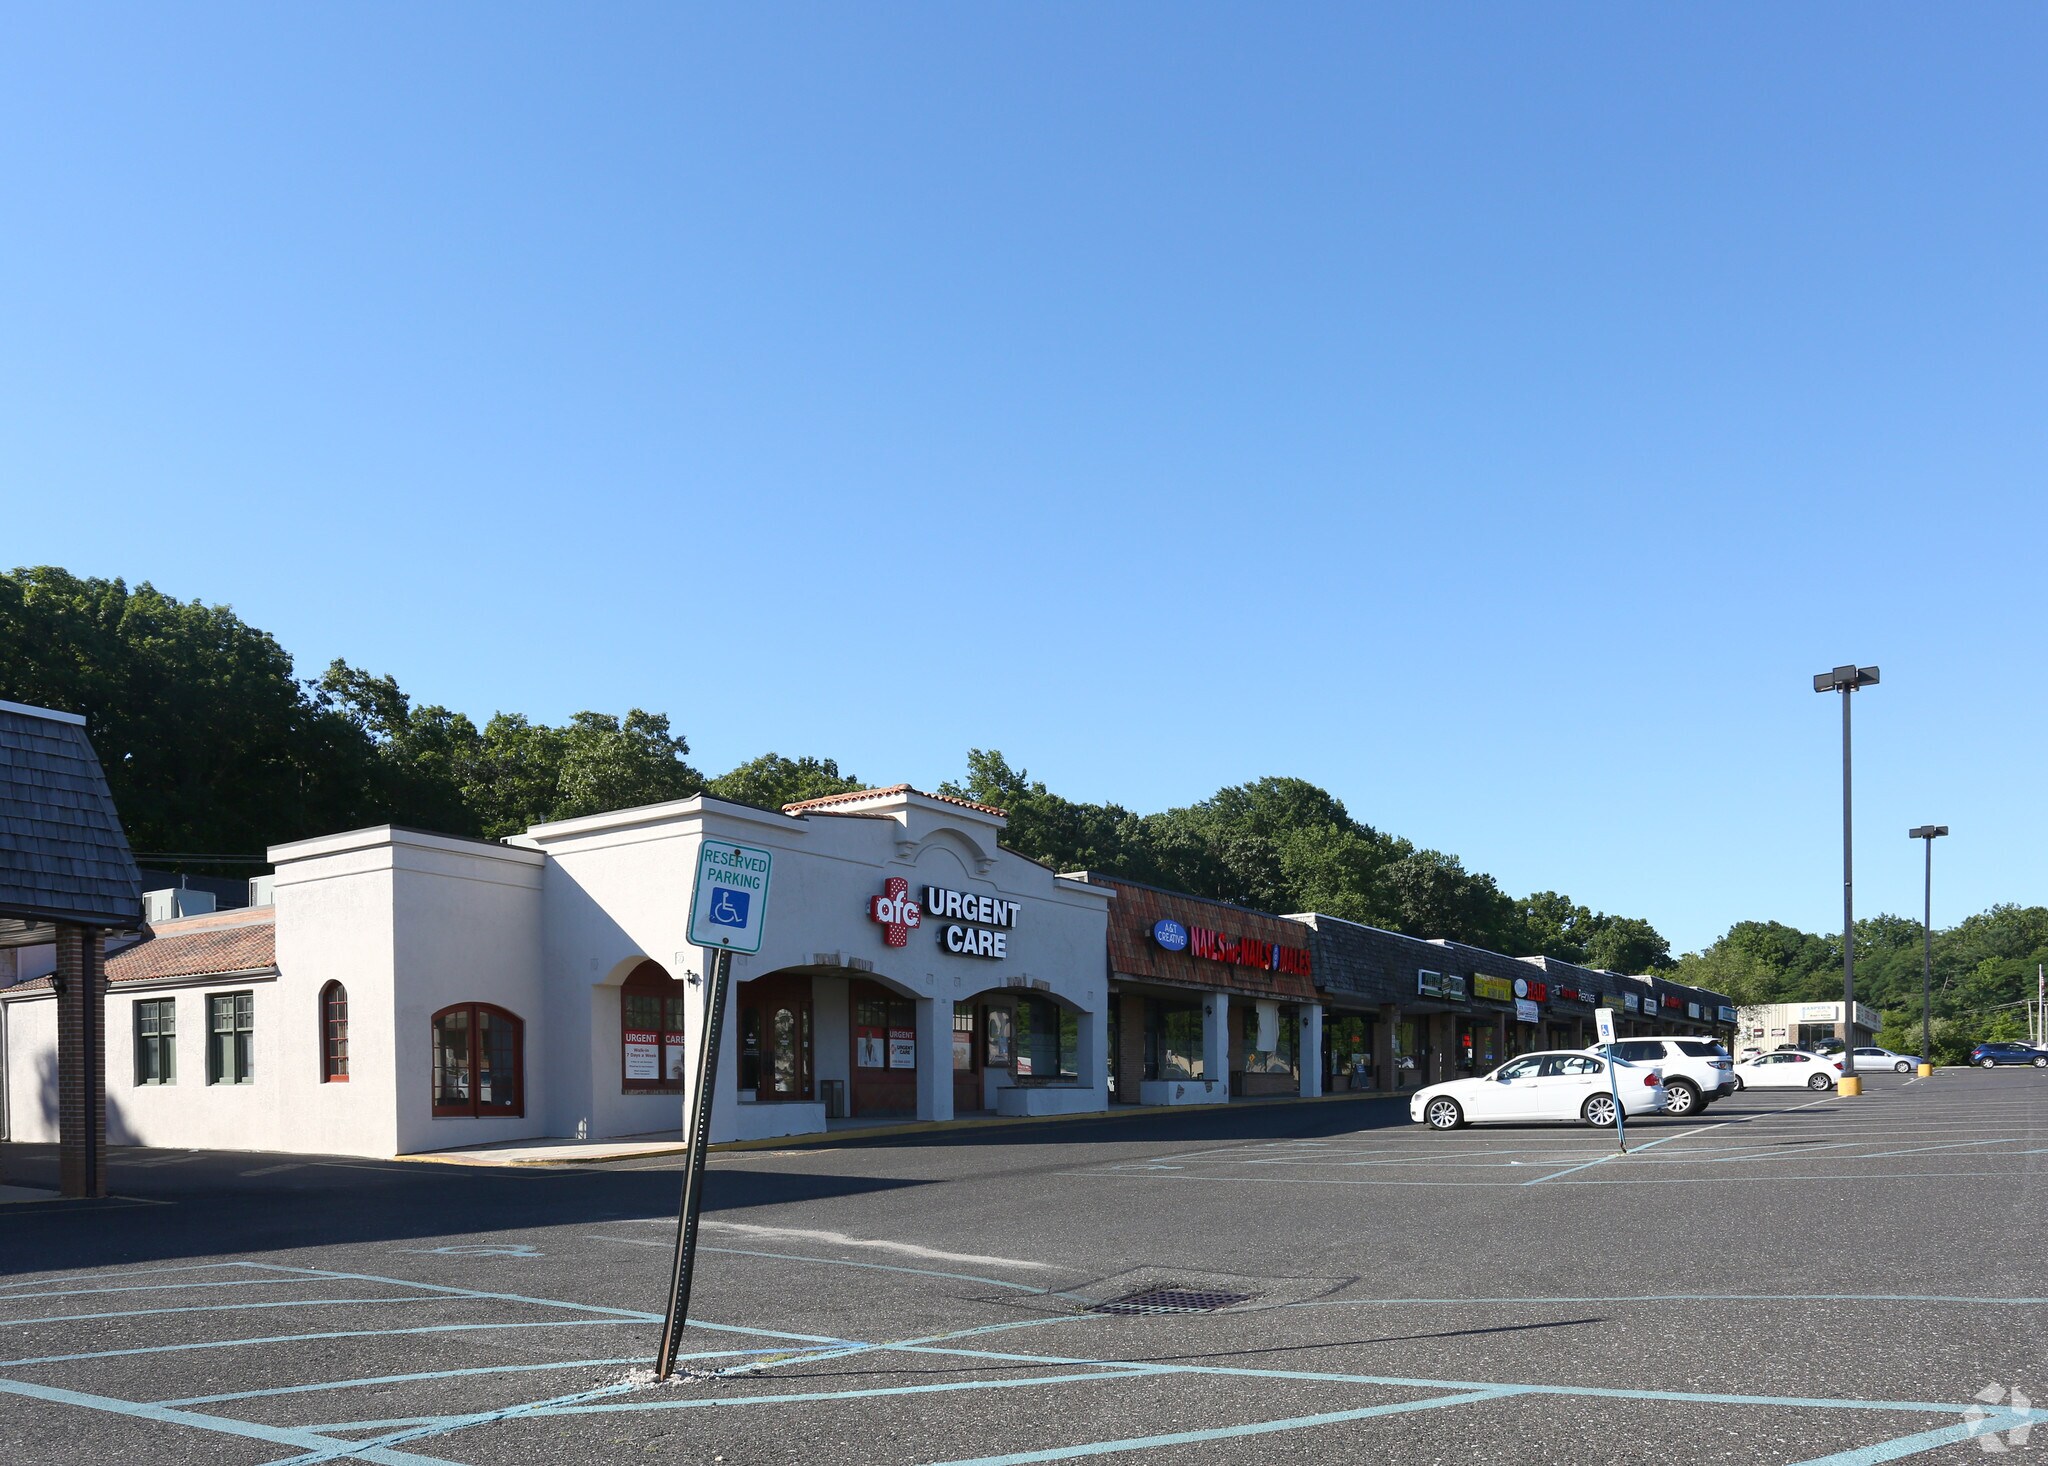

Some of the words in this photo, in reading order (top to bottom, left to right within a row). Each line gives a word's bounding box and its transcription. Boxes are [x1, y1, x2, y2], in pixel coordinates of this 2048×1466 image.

[704, 849, 767, 873] RESERVED
[707, 868, 761, 889] PARKING
[877, 890, 918, 926] afc
[928, 886, 1021, 928] URGENT
[947, 925, 1007, 958] CARE
[1157, 931, 1184, 945] CREATIVE
[1191, 926, 1226, 961] NAILS
[1241, 938, 1272, 970] NAILS
[1527, 980, 1547, 1002] HAIR
[625, 1033, 657, 1043] URGENT
[665, 1035, 685, 1044] CARE
[889, 1030, 914, 1039] URGENT
